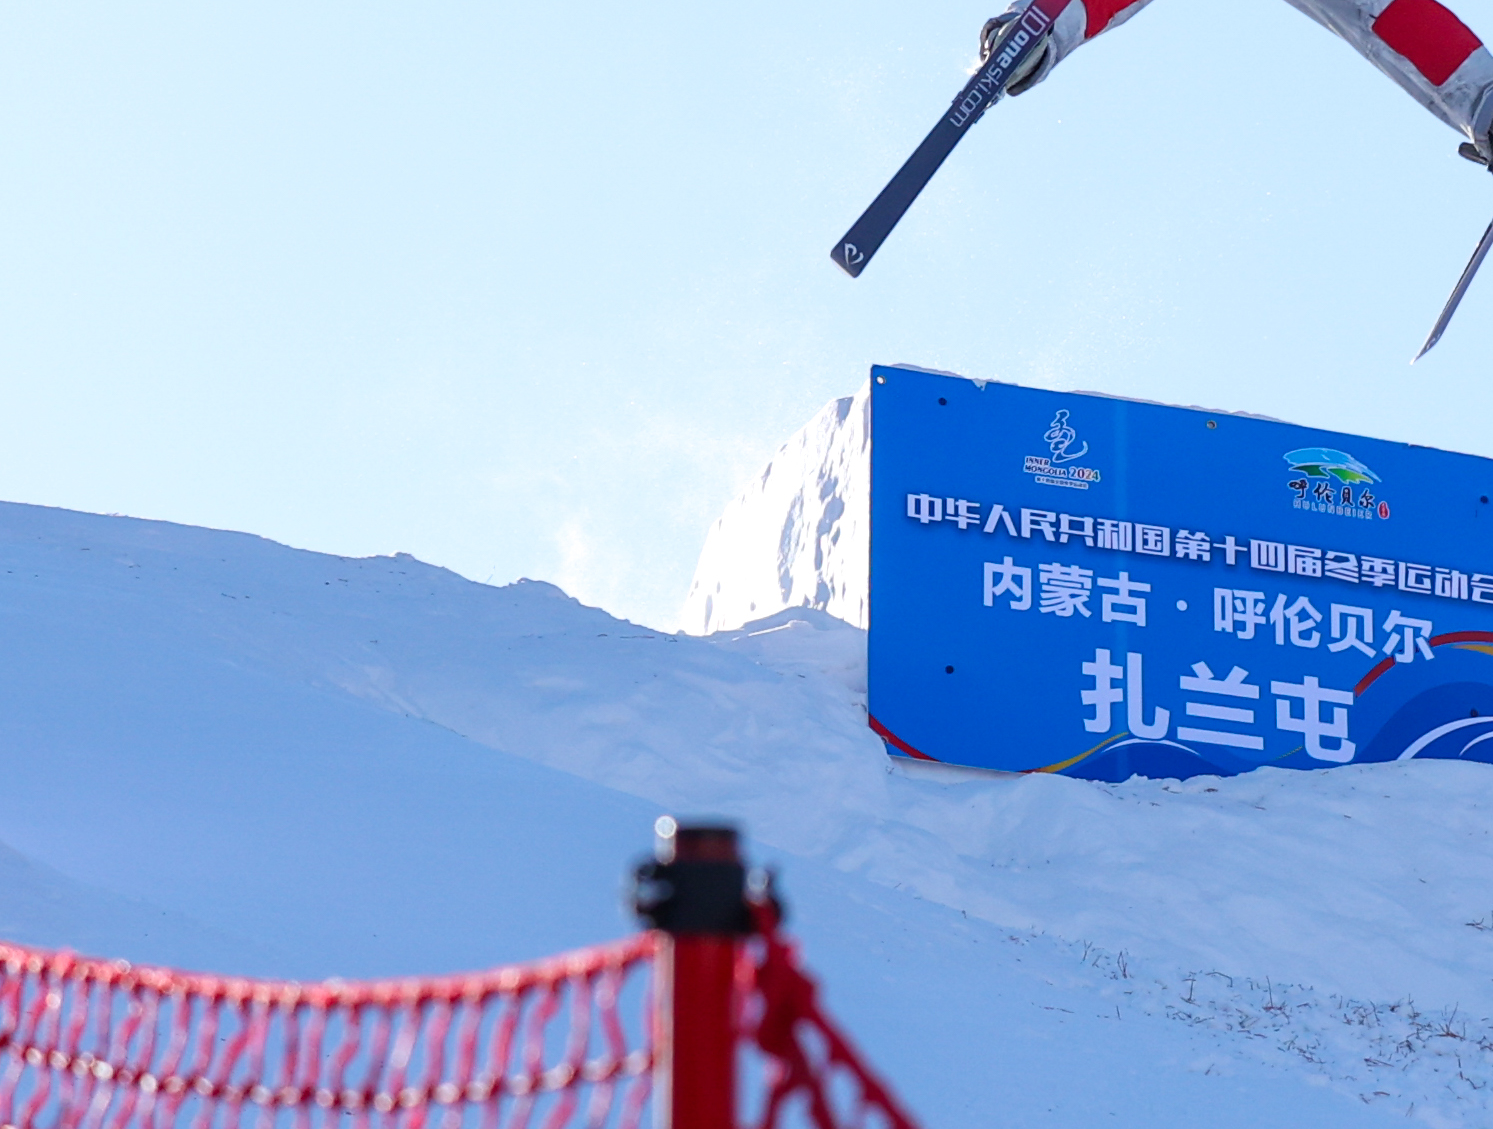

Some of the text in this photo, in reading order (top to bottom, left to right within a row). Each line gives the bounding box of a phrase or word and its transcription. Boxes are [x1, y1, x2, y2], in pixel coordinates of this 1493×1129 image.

[1024, 465, 1100, 482] MONGOLIA 2024
[1081, 649, 1356, 762] 扎兰屯
